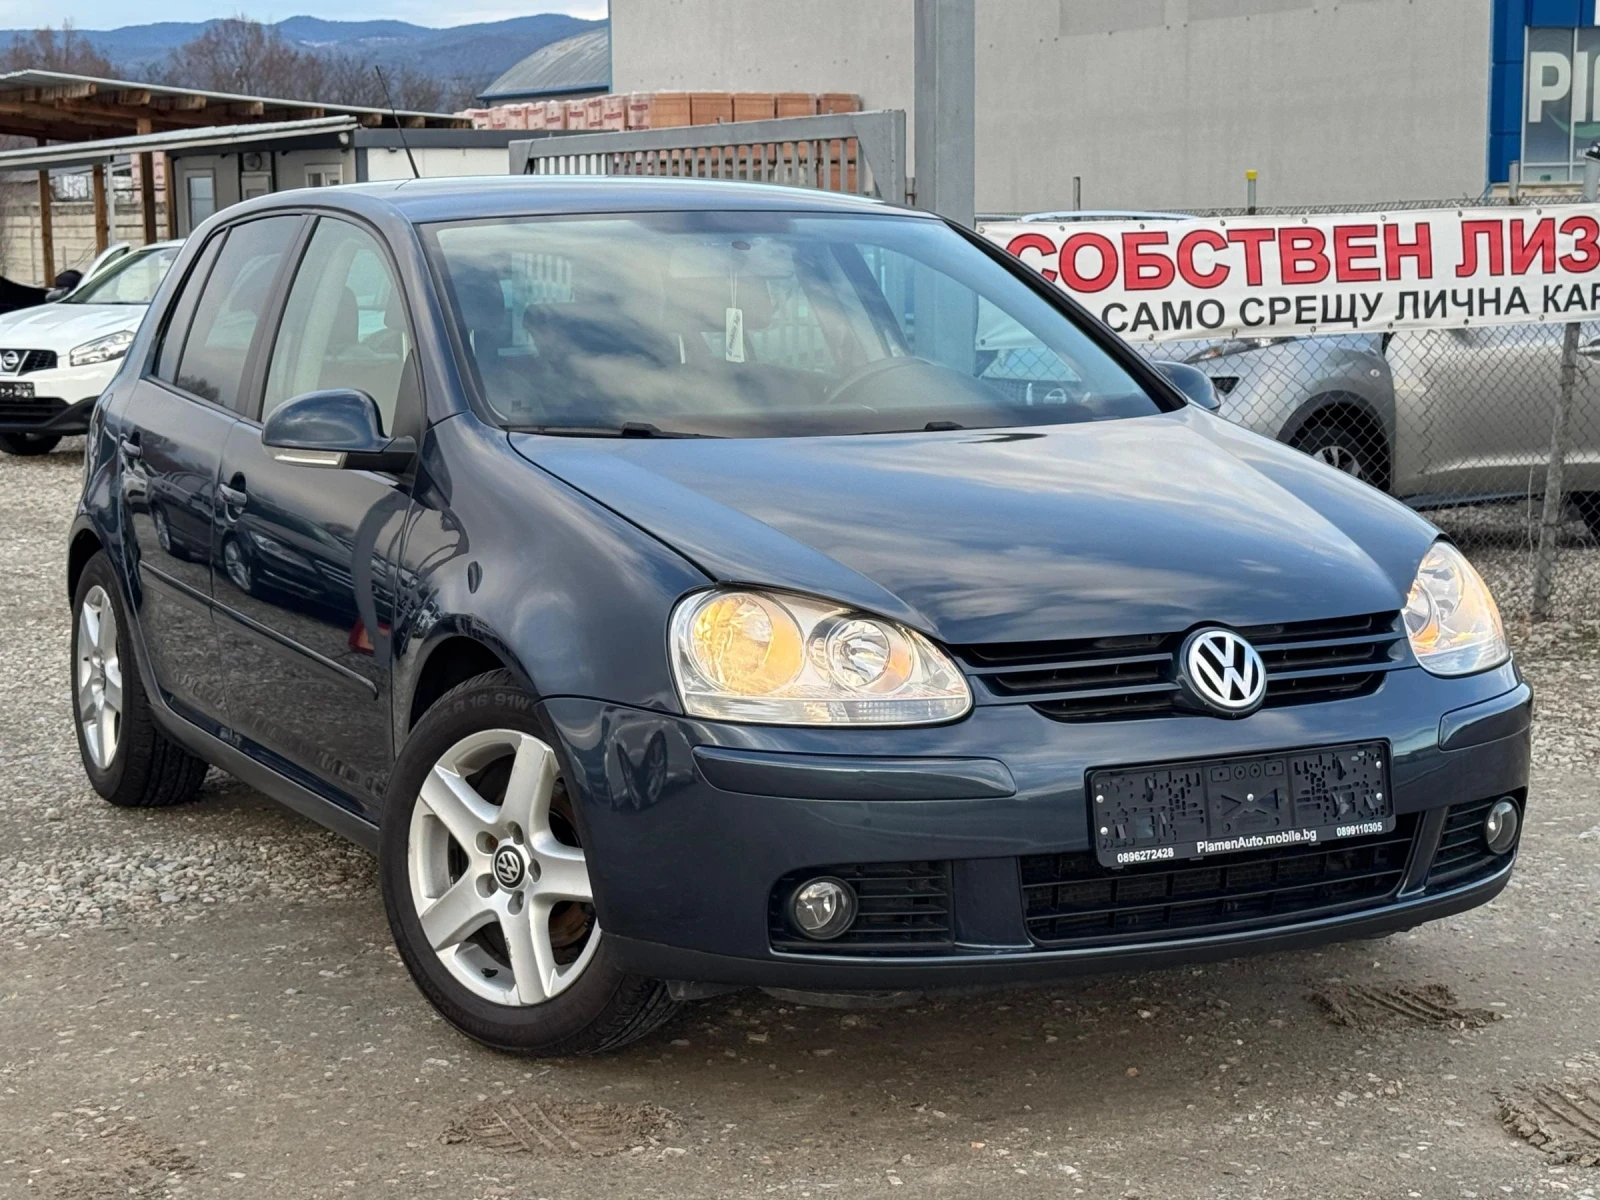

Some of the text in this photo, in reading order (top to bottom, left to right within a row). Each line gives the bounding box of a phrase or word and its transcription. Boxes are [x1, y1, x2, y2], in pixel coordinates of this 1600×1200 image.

[1455, 215, 1600, 278] ЛИЗ
[1102, 299, 1226, 333] САМО
[1239, 292, 1383, 328] СРЕЩУ
[1395, 286, 1530, 320] ЛИЧНА
[468, 693, 489, 709] 16
[494, 692, 531, 711] 91W
[1117, 821, 1383, 863] 0896272428 PlamenAuto.mobile.bg 0899110305
